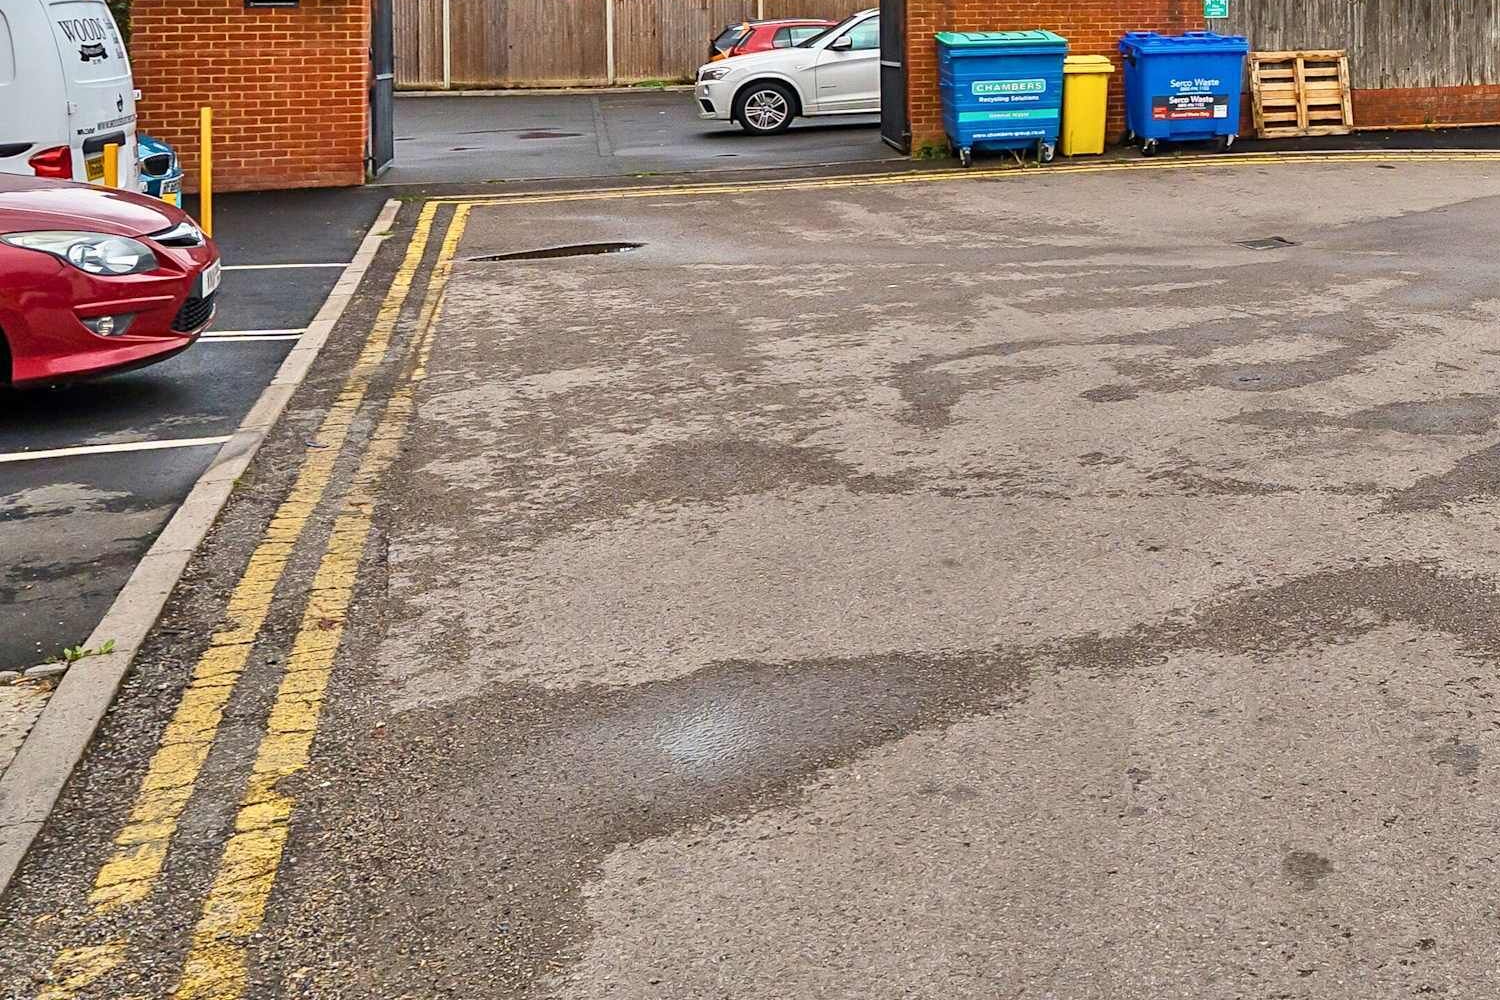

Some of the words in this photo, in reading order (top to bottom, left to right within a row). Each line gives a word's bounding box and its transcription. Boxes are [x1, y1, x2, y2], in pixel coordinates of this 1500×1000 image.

[976, 82, 1042, 92] CHAMBERS
[1169, 80, 1193, 88] Serco
[1194, 78, 1220, 86] Waste
[1169, 96, 1190, 104] Serco
[1190, 95, 1214, 103] Waste
